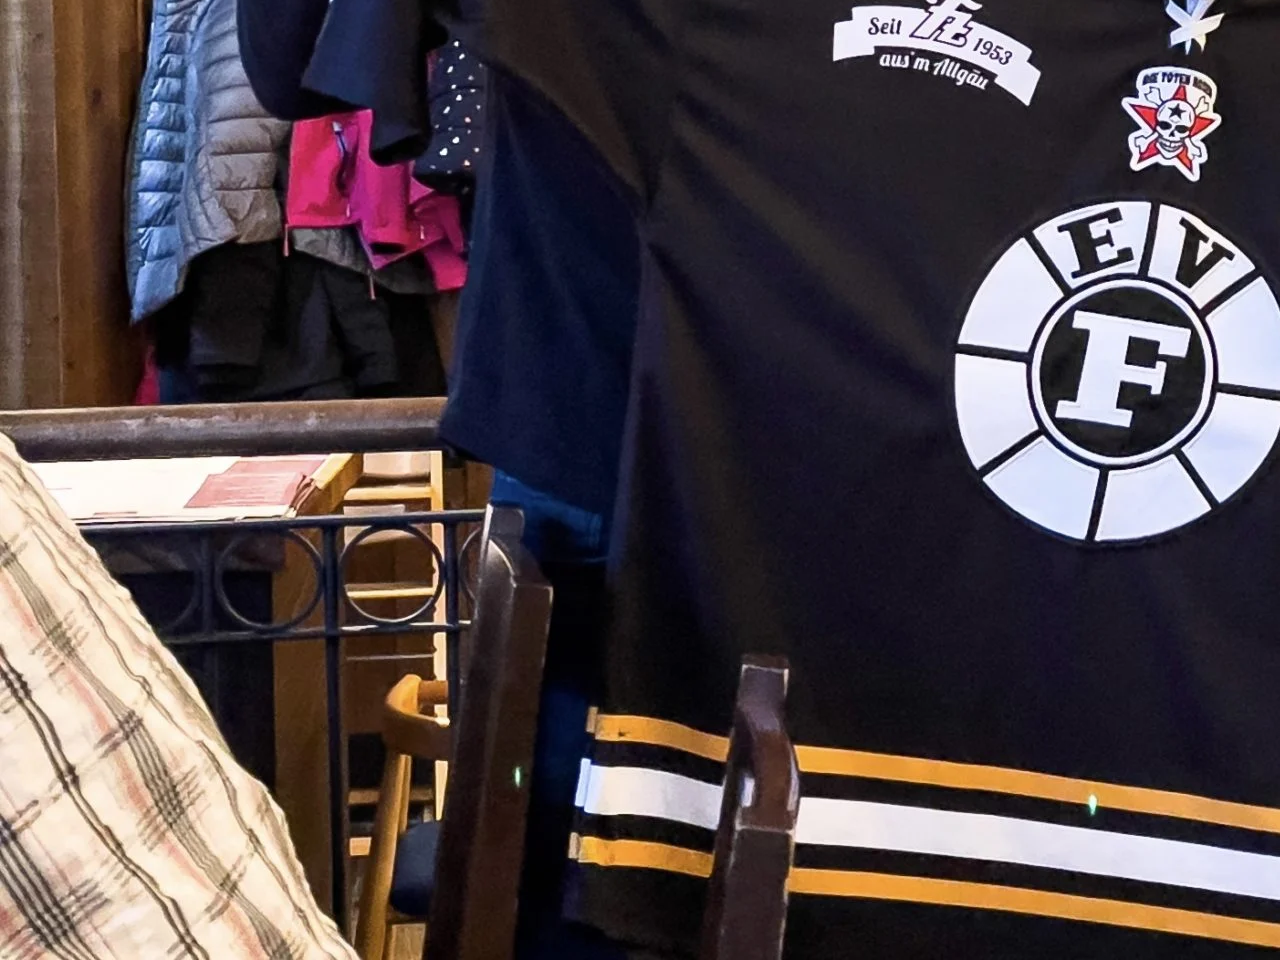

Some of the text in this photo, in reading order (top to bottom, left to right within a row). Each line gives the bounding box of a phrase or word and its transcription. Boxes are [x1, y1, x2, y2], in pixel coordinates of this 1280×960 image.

[868, 17, 1013, 66] Seit 1953
[933, 58, 990, 90] Allgäu
